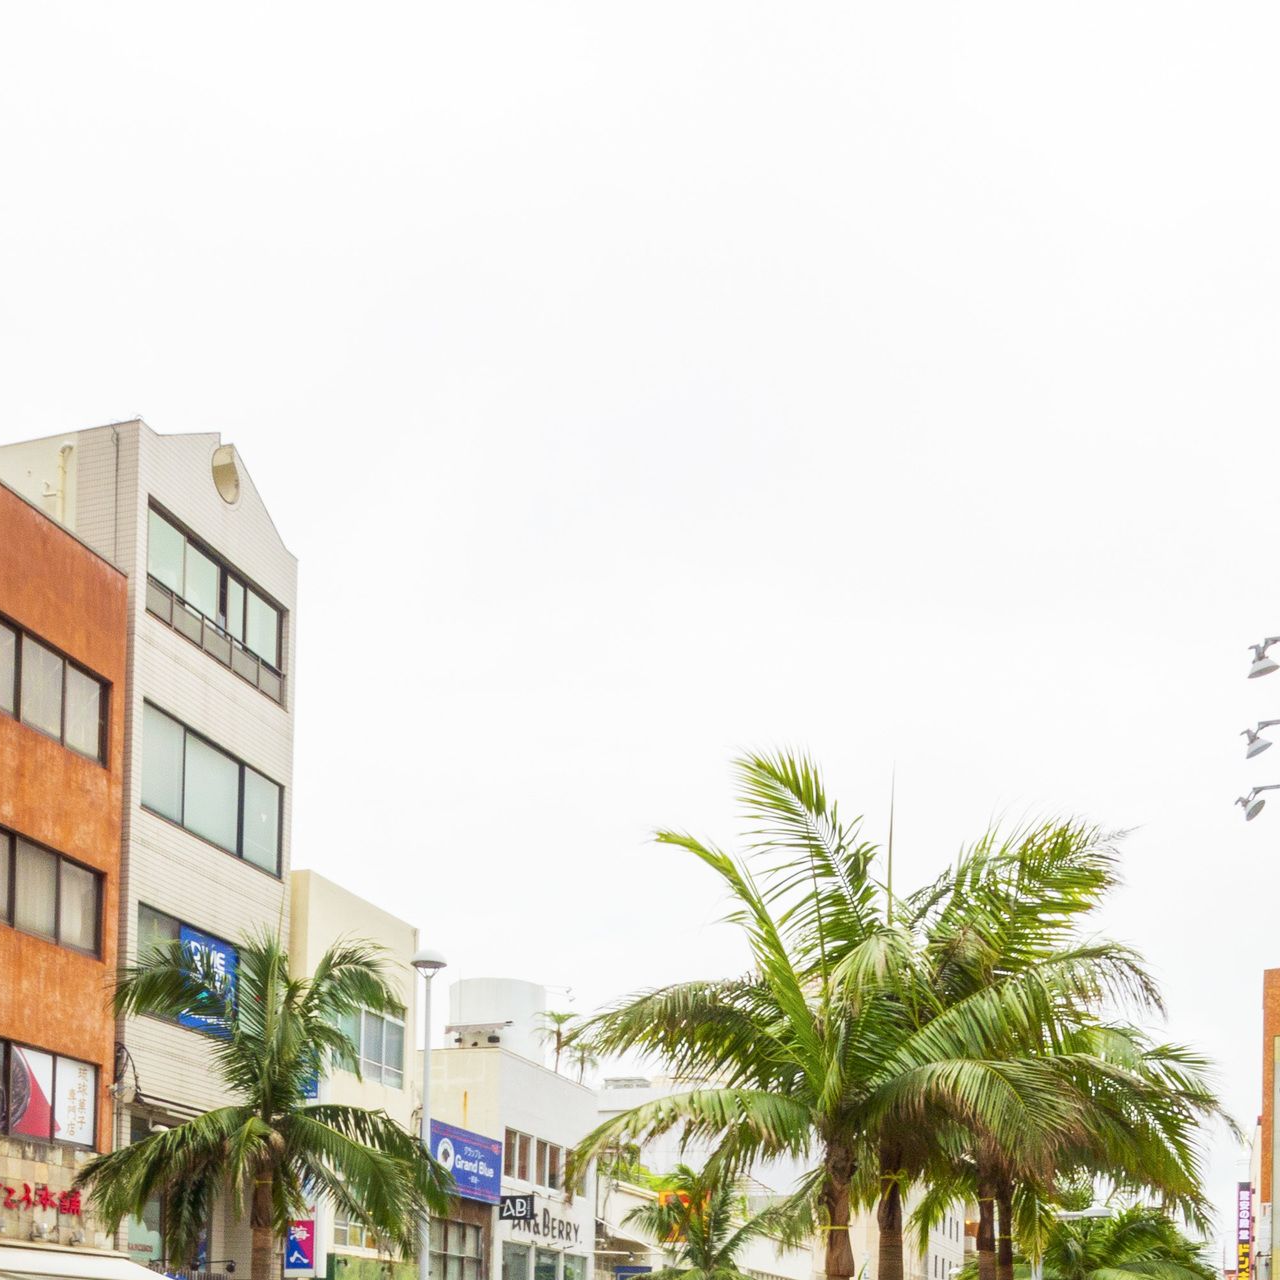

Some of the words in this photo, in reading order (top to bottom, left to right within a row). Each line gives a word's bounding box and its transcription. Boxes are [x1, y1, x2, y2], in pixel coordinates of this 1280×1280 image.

[455, 1154, 478, 1173] Grand
[478, 1161, 494, 1178] Blue
[502, 1199, 527, 1217] AB
